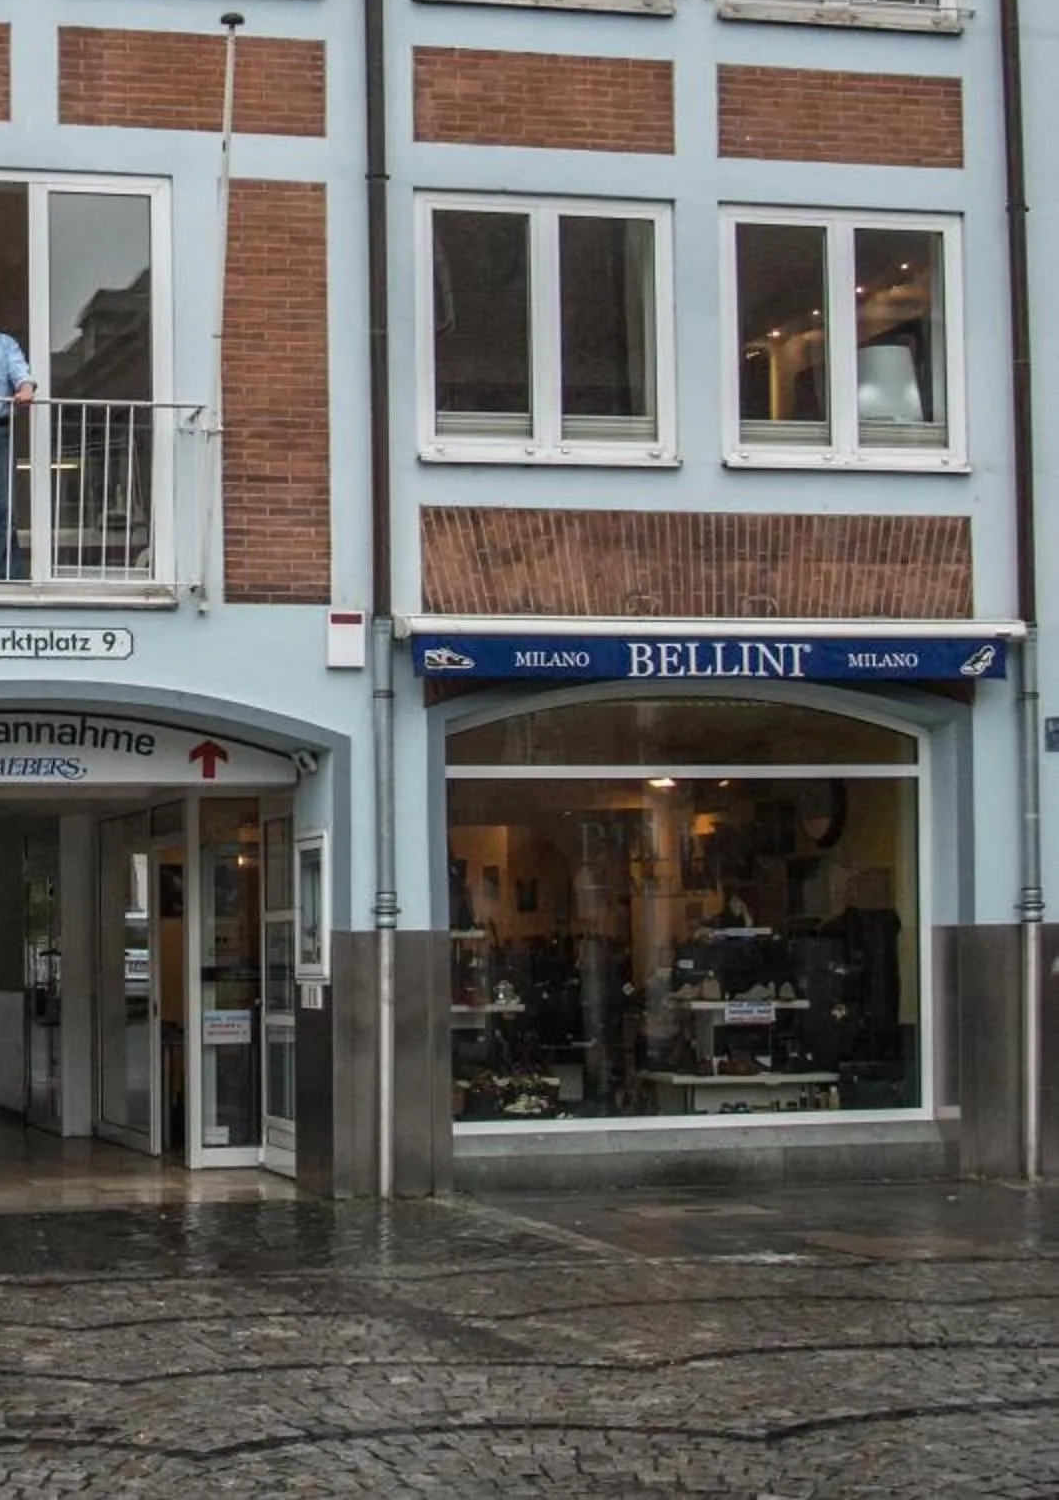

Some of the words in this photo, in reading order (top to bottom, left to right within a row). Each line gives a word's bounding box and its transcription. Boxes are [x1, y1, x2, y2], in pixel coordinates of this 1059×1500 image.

[102, 631, 117, 651] 9
[514, 650, 590, 668] MILANO
[847, 652, 919, 669] MILANO
